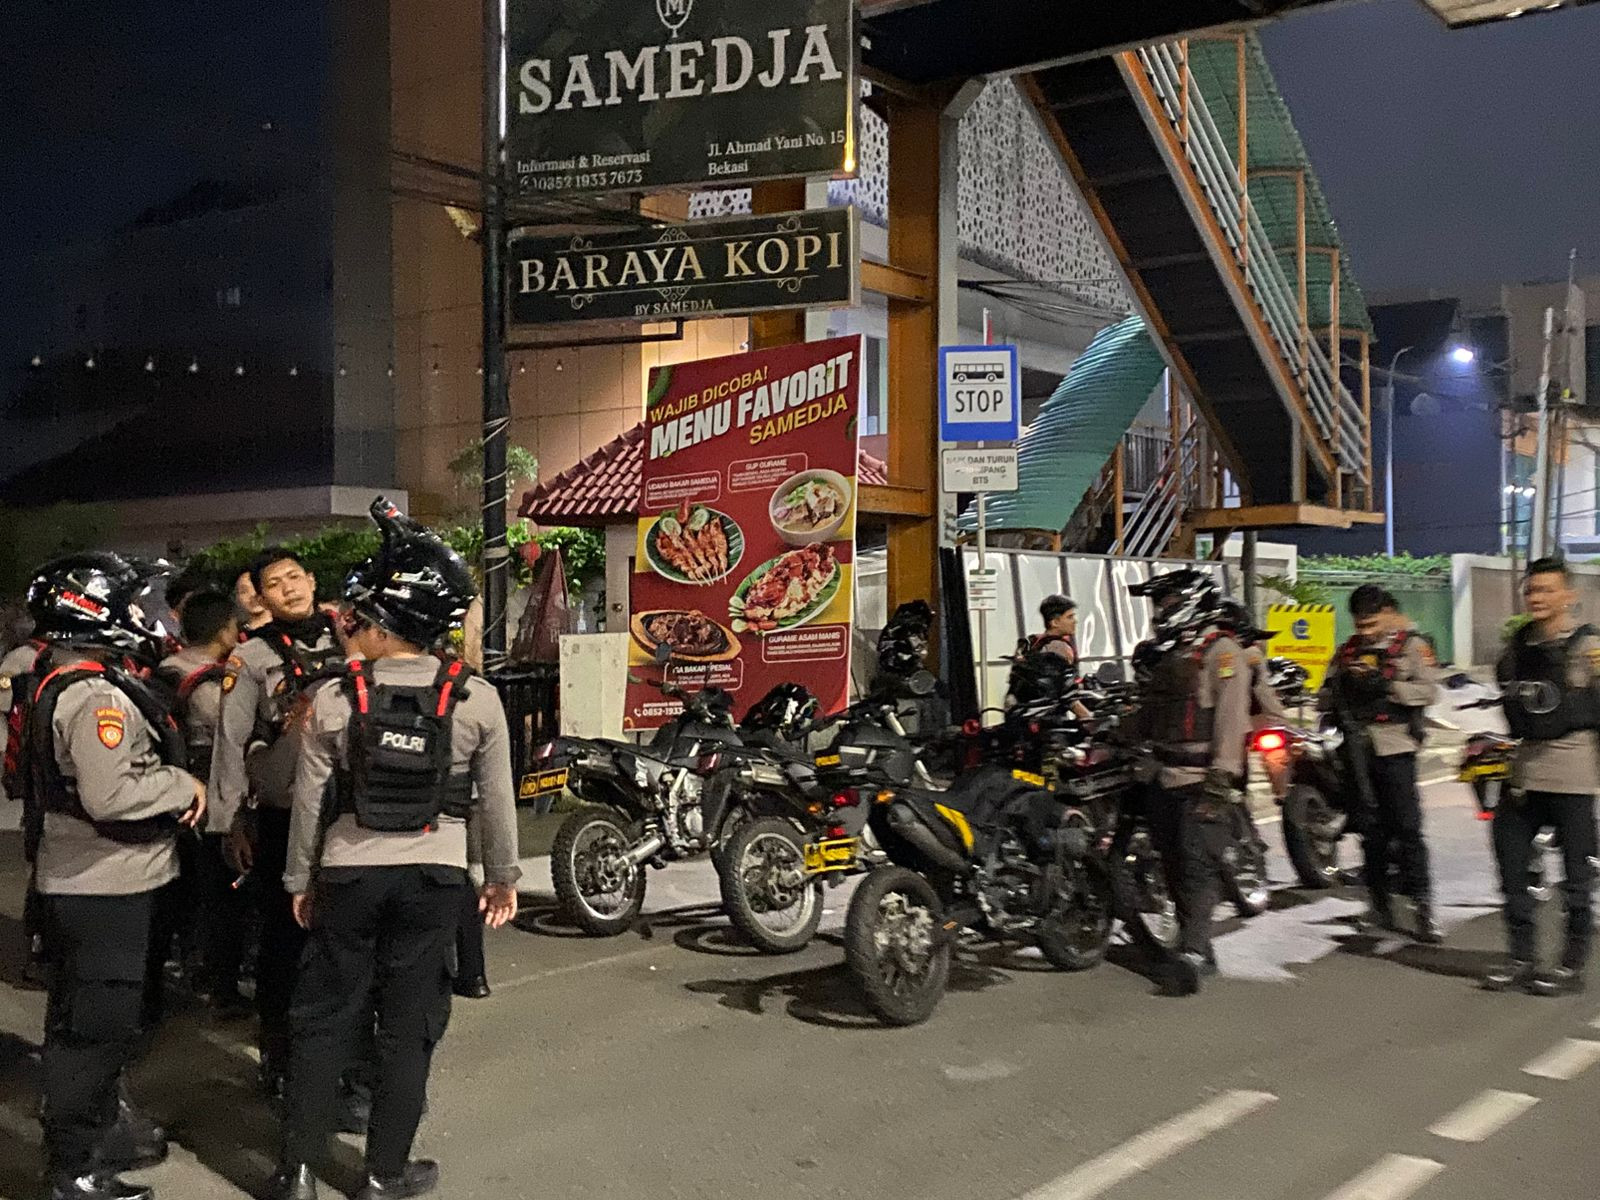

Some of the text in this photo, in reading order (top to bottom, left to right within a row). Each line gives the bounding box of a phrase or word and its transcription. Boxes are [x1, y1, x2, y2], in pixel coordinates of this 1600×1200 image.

[519, 24, 843, 115] SAMEDJA
[725, 138, 772, 154] Ahmad
[774, 135, 803, 149] Yani
[805, 133, 827, 147] No.
[830, 130, 846, 144] 15
[517, 150, 651, 174] Informasi & Reservasi
[708, 160, 749, 176] Bekasi
[575, 172, 607, 187] 1933
[609, 169, 644, 185] 7673
[519, 232, 843, 294] BARAYA KOPI
[634, 299, 715, 316] BY SAMEDJA
[650, 366, 767, 424] WAJIB DICOBA!
[650, 352, 853, 460] MENU FAVORIT
[955, 391, 1003, 412] STOP
[750, 394, 848, 445] SAMEDJA
[967, 456, 985, 464] DAN
[986, 456, 1015, 464] TURUN
[381, 731, 426, 752] POLRI
